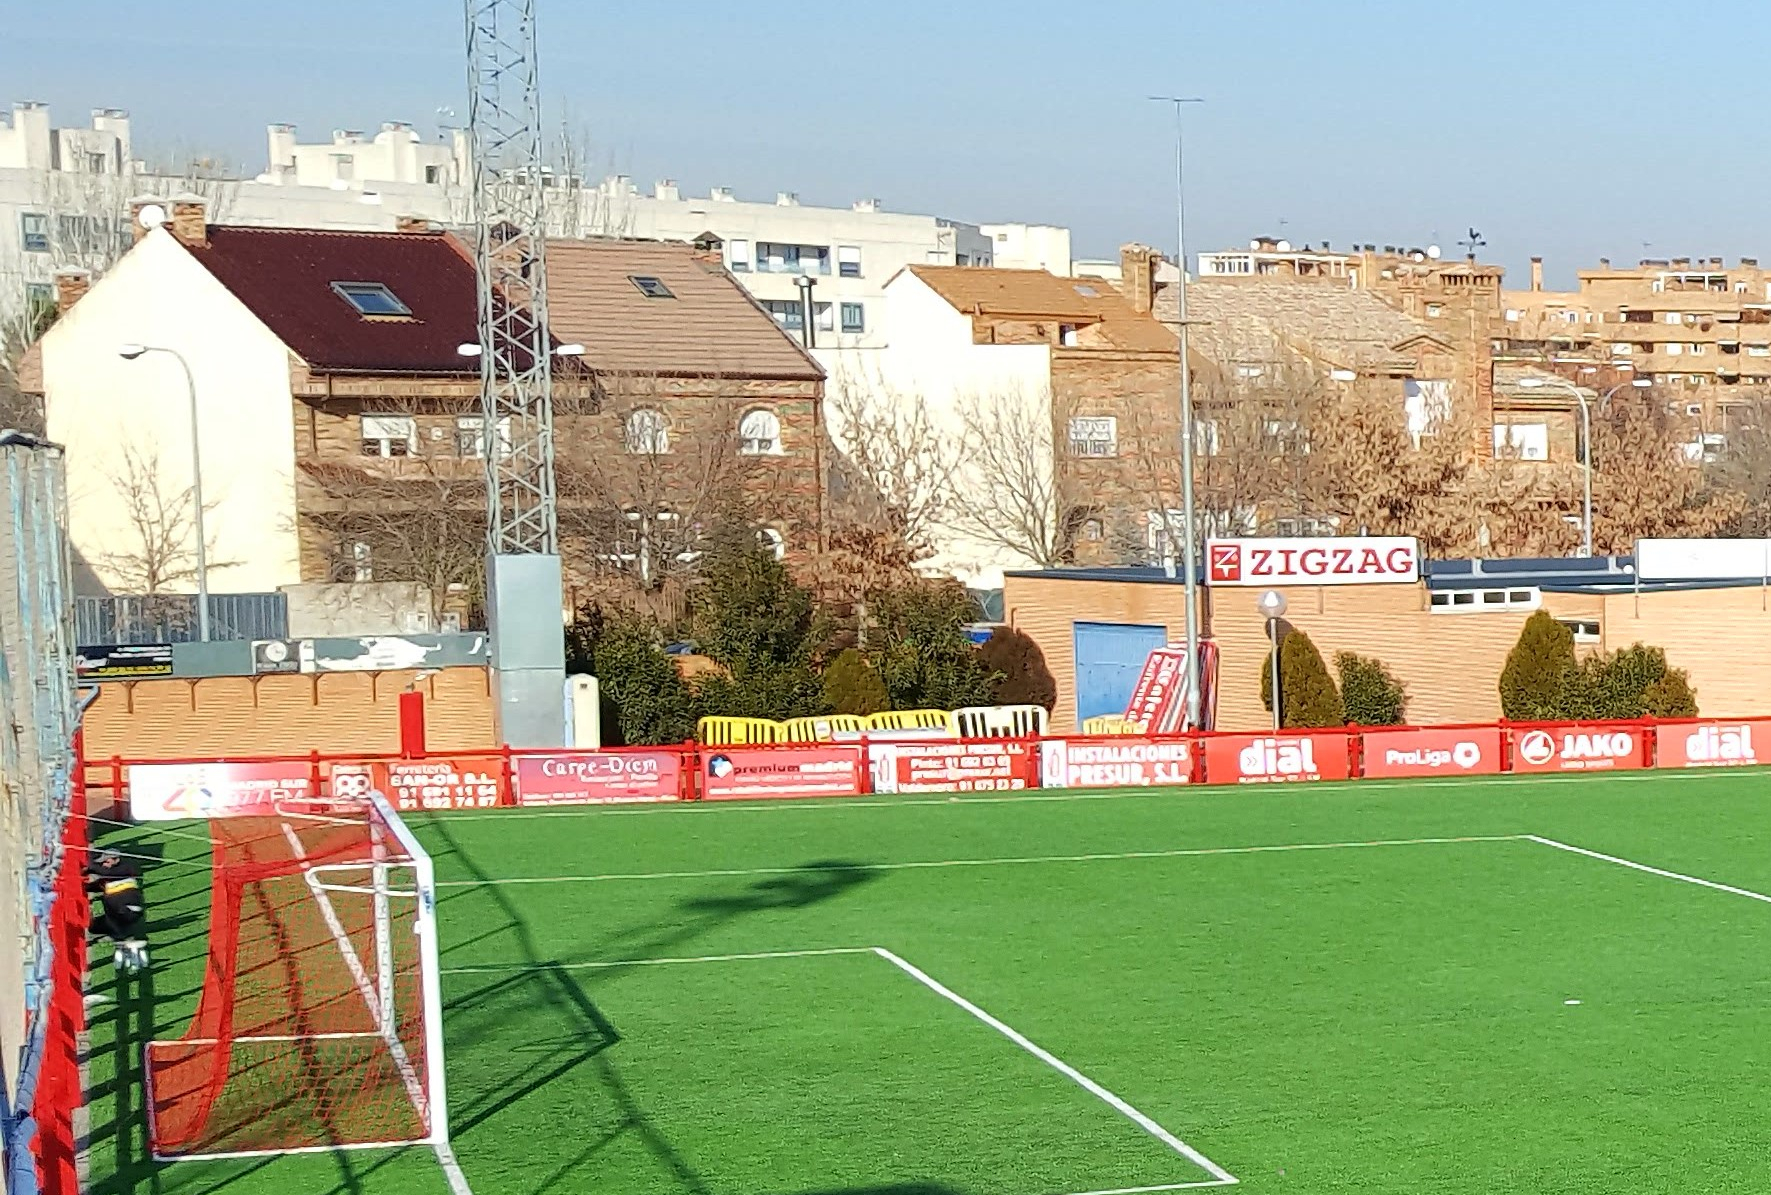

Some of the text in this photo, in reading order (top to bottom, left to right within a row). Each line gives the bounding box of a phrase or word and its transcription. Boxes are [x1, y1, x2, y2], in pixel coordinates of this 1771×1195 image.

[1250, 548, 1413, 575] ZIGZAG
[1068, 745, 1188, 764] INSTALACIONES
[1560, 732, 1633, 759] JAKO
[1686, 724, 1755, 760] dial
[542, 757, 658, 776] Carpe-Diem
[1239, 737, 1319, 775] dial
[1385, 749, 1452, 767] ProLiga
[1068, 763, 1151, 786] PRESUR,
